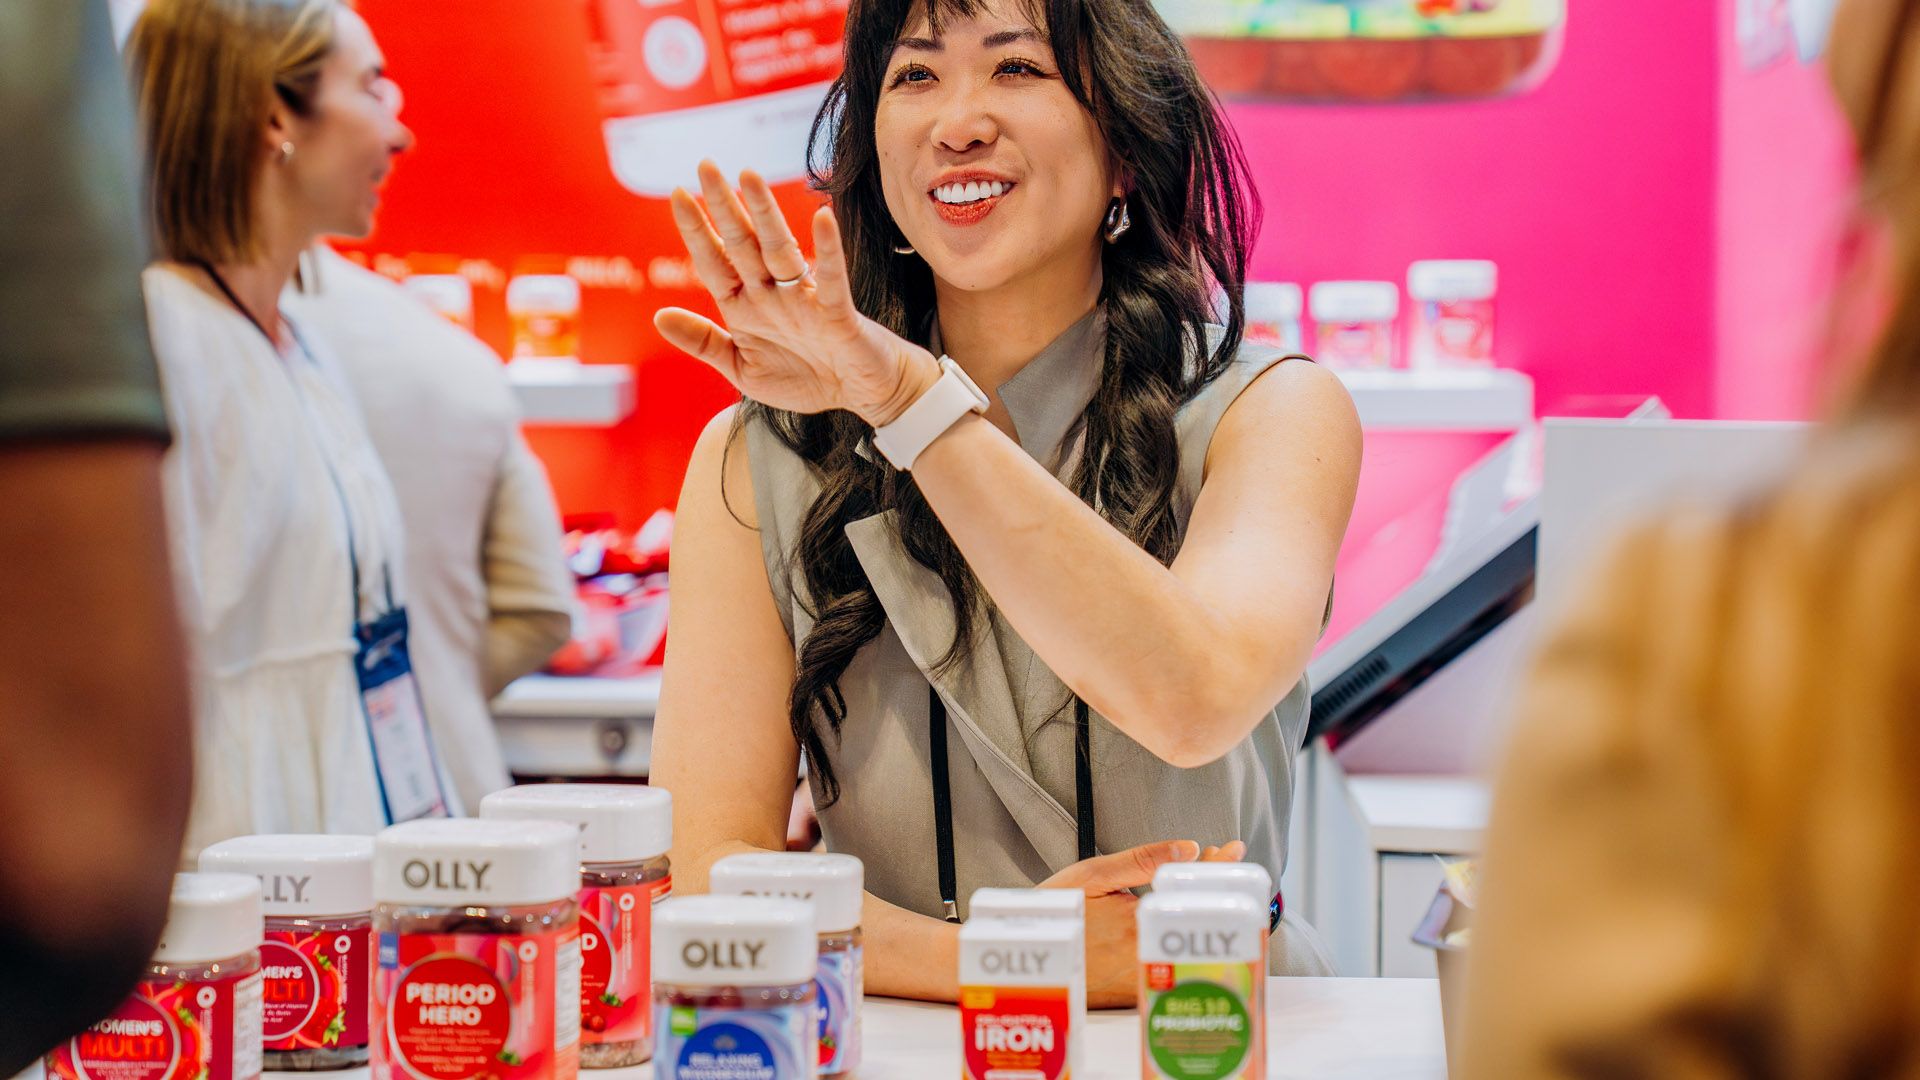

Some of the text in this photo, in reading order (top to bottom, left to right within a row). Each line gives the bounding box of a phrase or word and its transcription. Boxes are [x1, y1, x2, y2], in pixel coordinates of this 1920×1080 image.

[402, 859, 493, 890] OLLY
[681, 939, 766, 969] OLLY
[1159, 929, 1239, 957] OLLY
[979, 948, 1050, 975] OLLY
[406, 982, 497, 1005] PERIOD
[419, 1005, 482, 1026] HERO
[81, 1033, 166, 1058] MULTI
[975, 1023, 1055, 1052] IRON
